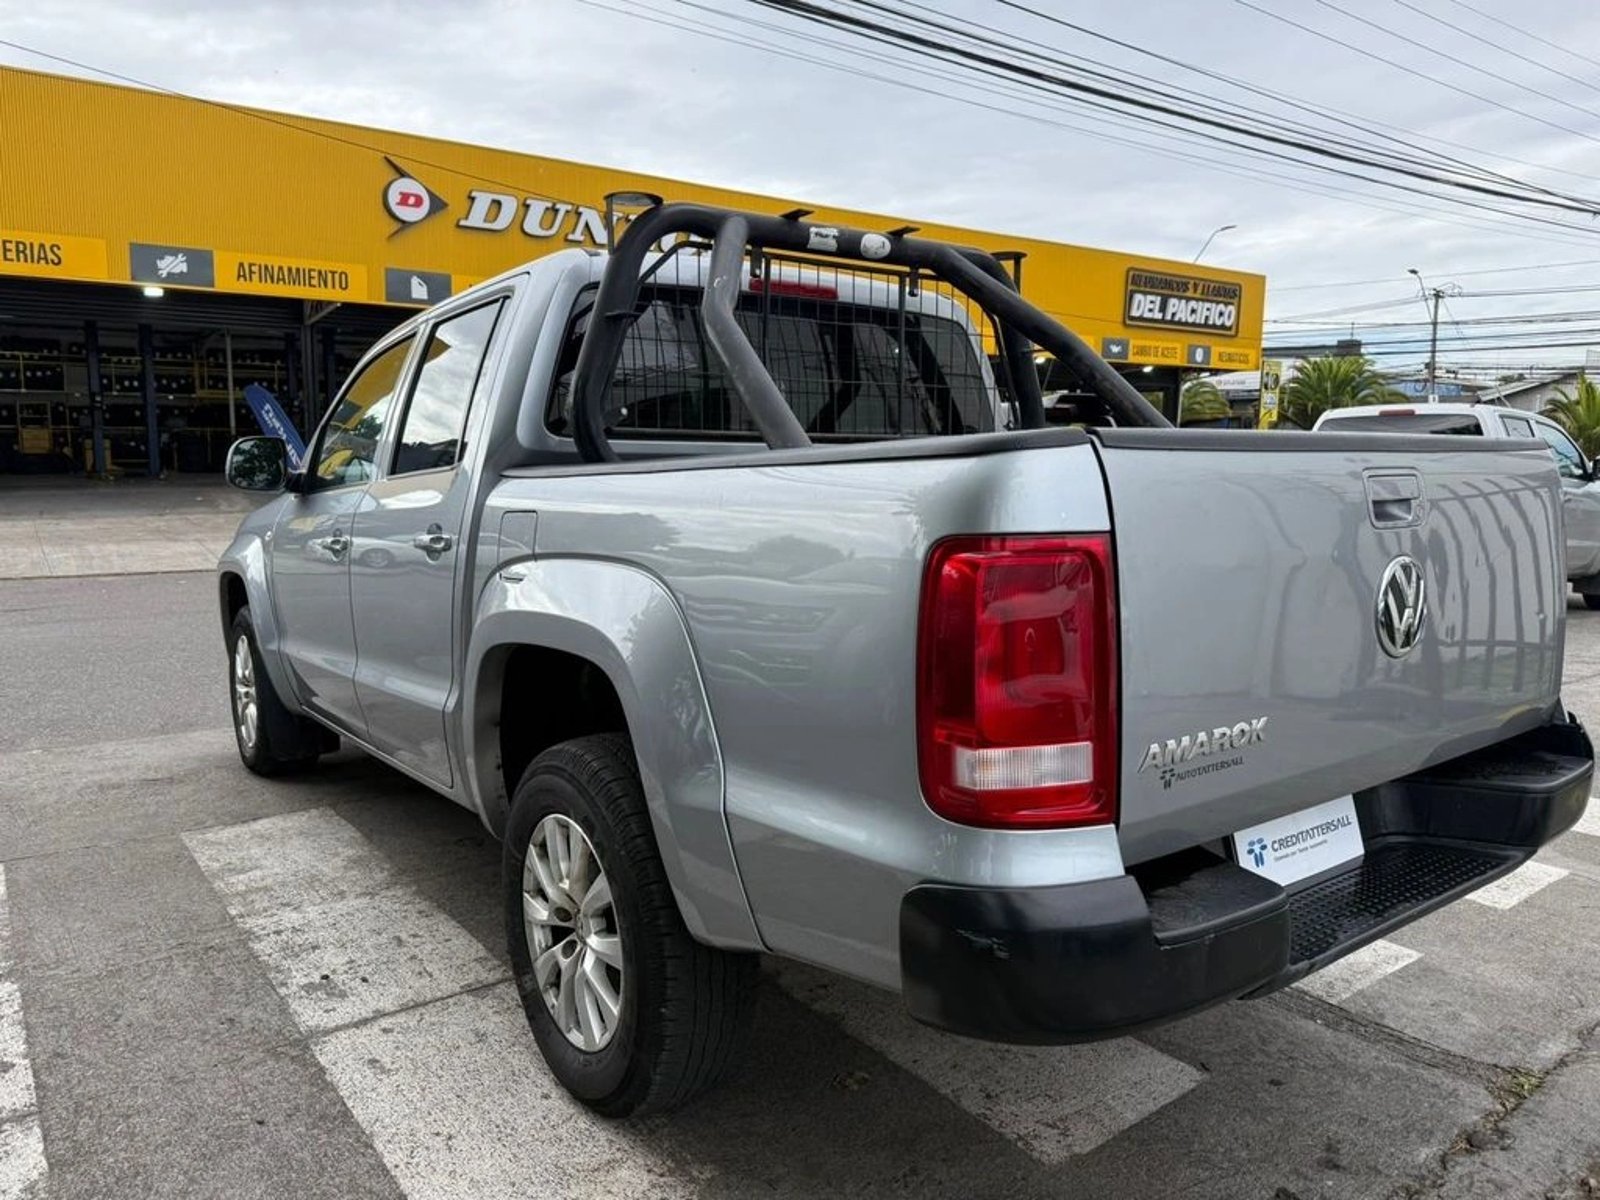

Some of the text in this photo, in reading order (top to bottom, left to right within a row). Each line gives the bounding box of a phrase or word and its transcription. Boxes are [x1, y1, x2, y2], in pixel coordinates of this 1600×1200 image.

[236, 261, 349, 291] AFINAMIENTO
[1130, 293, 1235, 327] DEL PACIFICO
[1138, 716, 1268, 773] AMAROK
